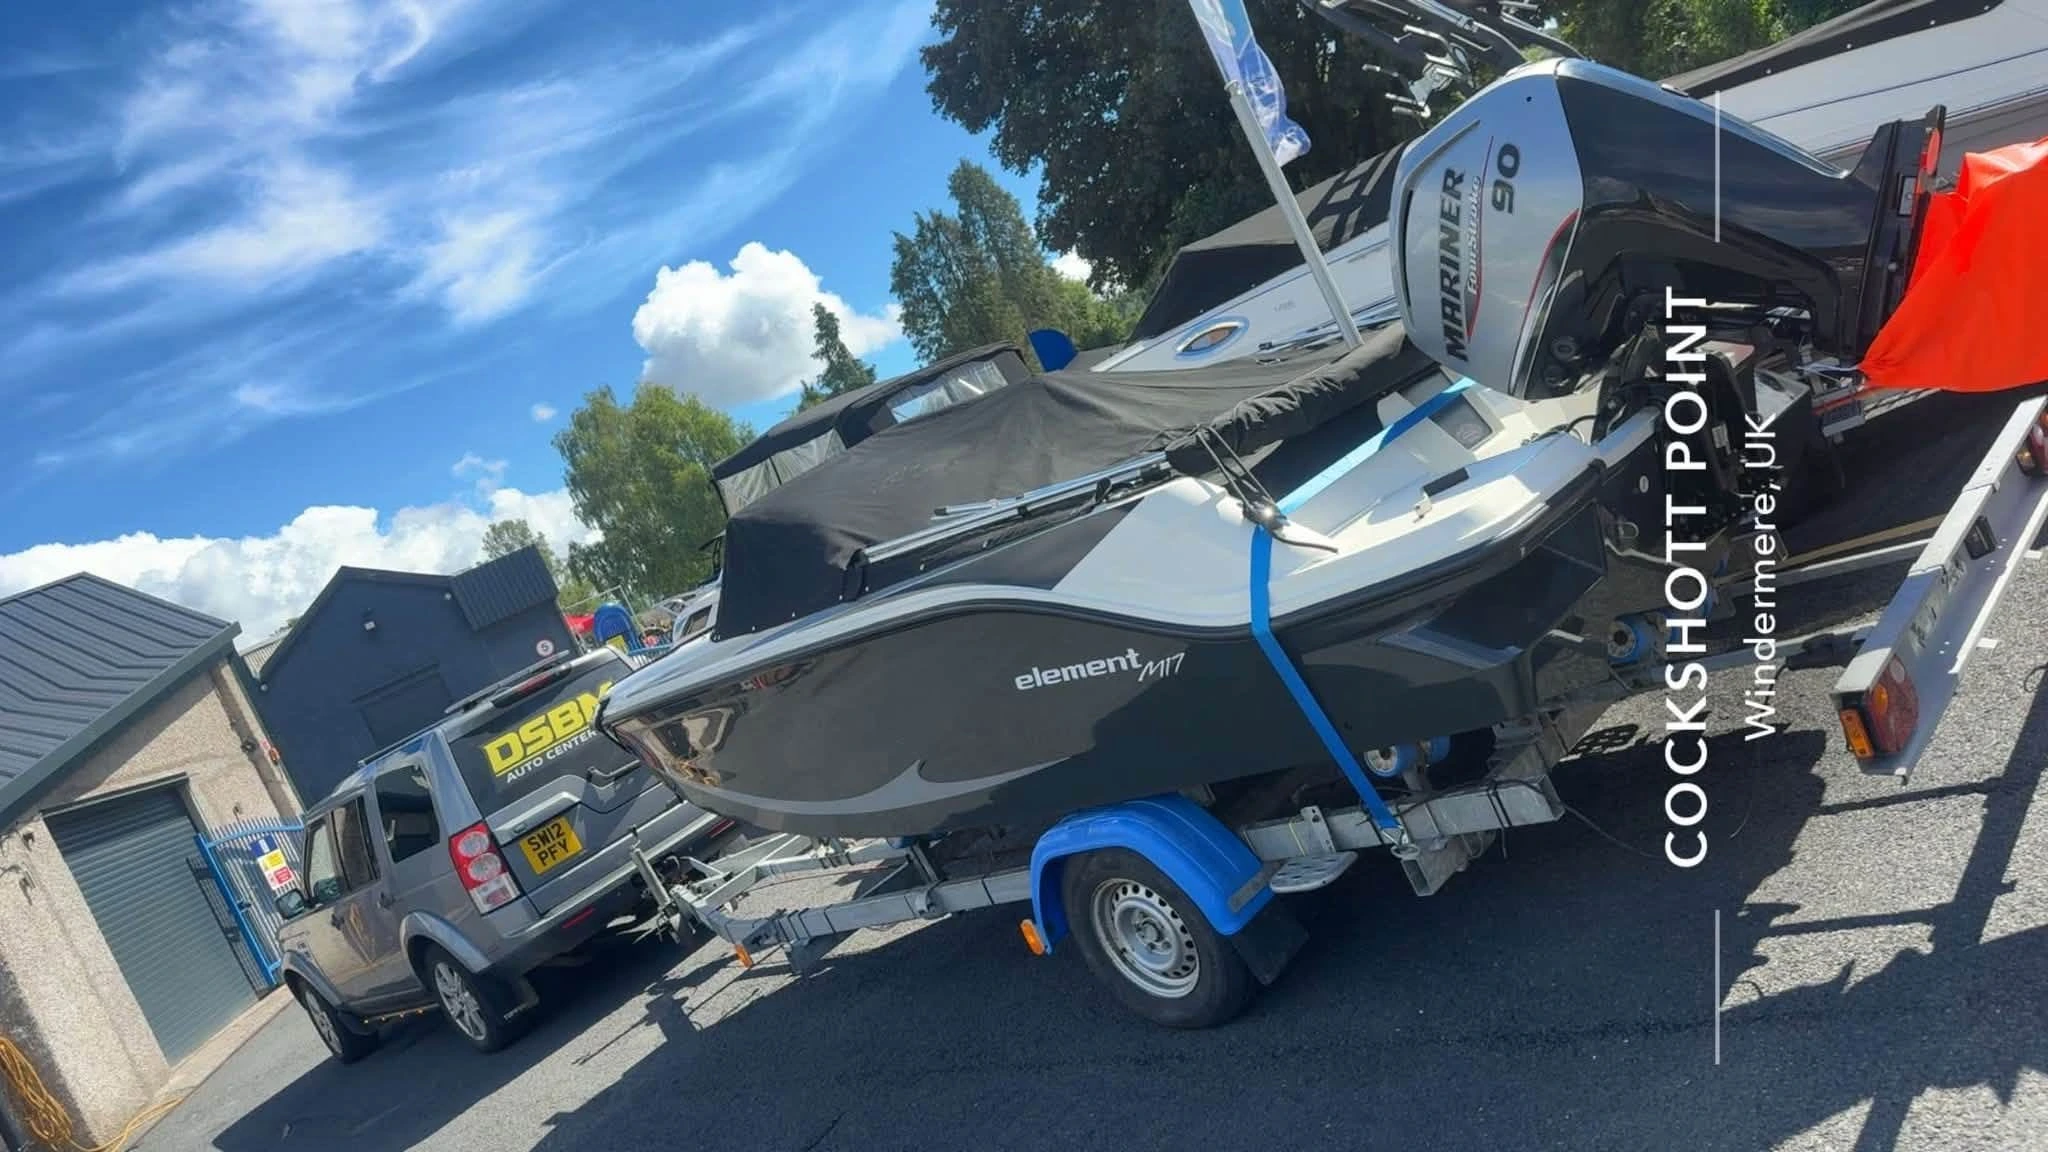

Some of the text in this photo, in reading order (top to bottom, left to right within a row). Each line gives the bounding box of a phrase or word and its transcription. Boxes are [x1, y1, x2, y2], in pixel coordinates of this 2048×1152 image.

[1492, 143, 1521, 214] 90
[1438, 167, 1469, 362] MARINER
[1014, 648, 1186, 691] element M17
[506, 757, 545, 783] AUTO
[527, 823, 566, 852] SW12
